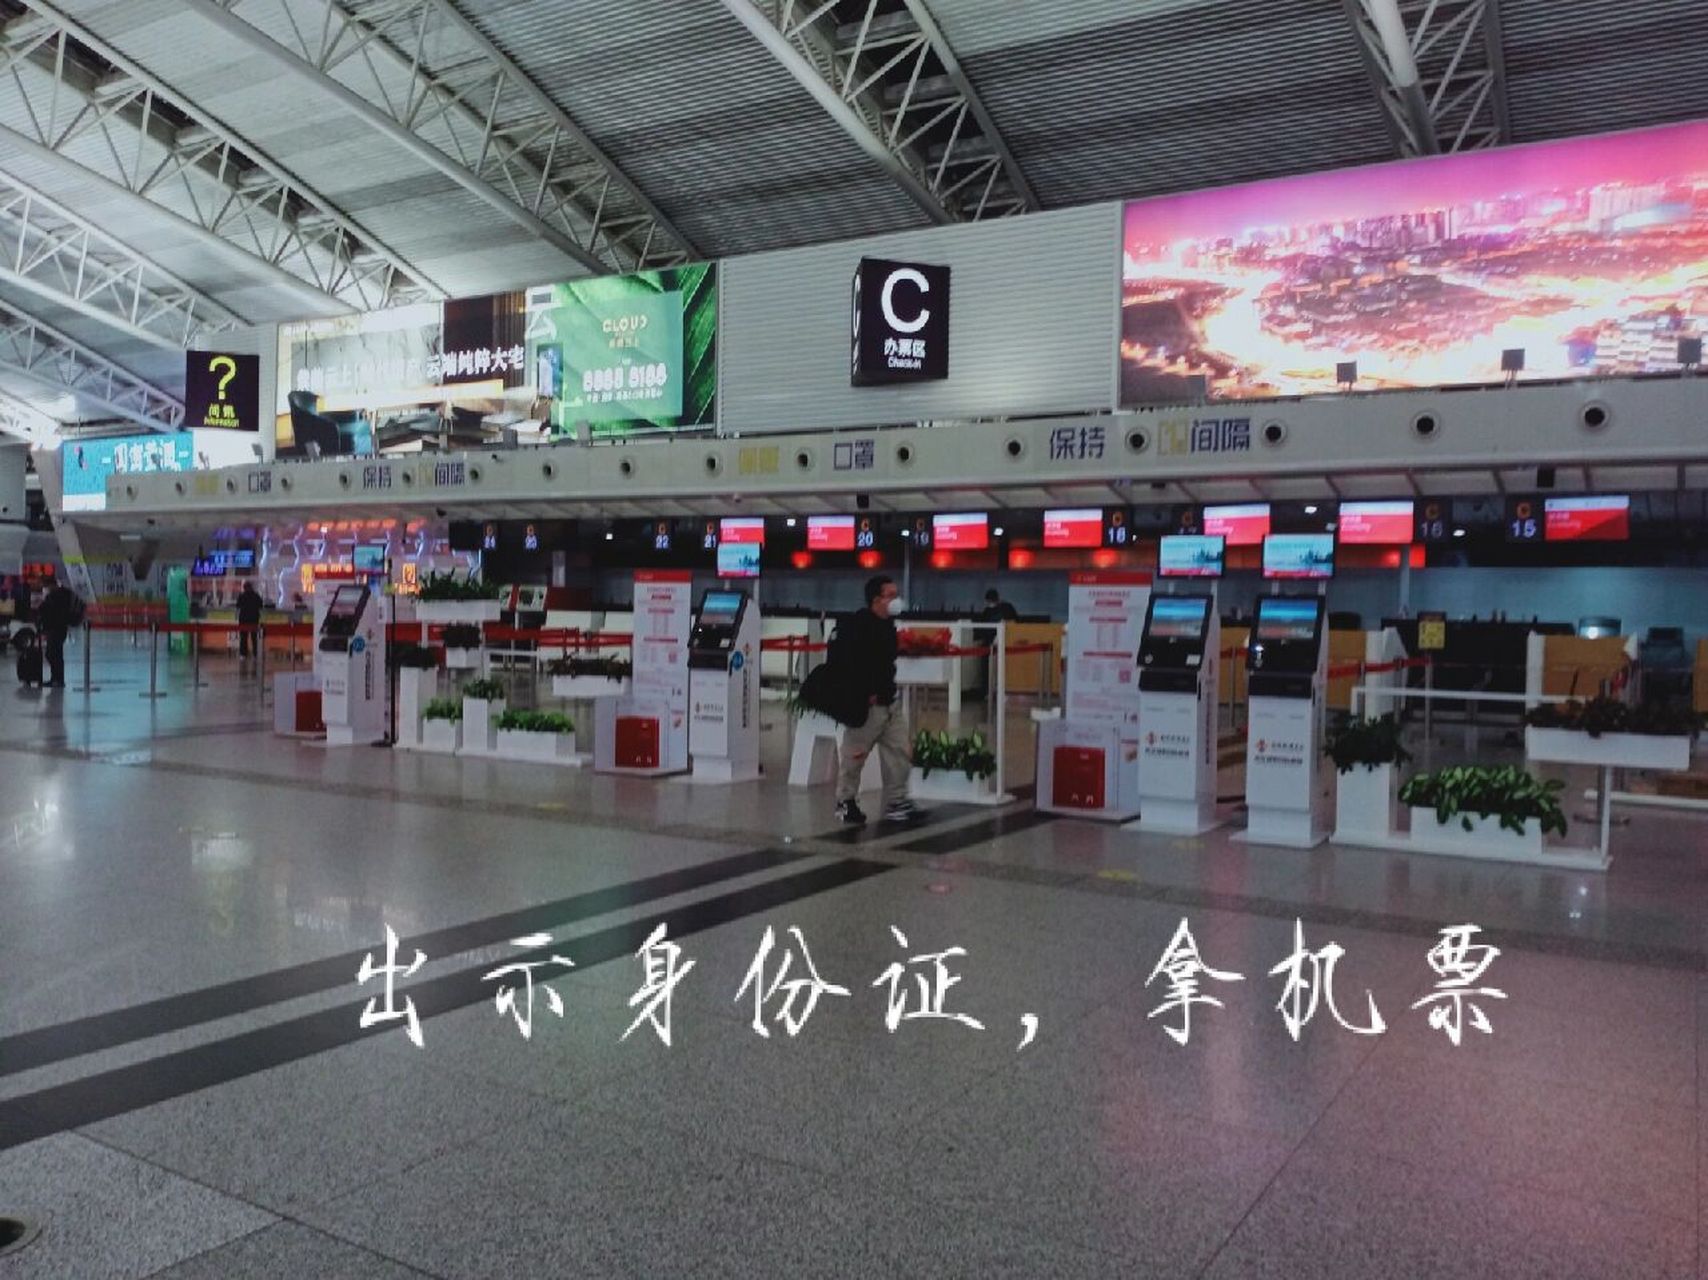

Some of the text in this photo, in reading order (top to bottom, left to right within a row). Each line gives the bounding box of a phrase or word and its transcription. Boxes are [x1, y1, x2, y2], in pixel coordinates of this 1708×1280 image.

[881, 268, 930, 333] C
[884, 338, 926, 358] 办票区
[1050, 429, 1105, 460] 保持
[1191, 418, 1252, 453] 间隔
[834, 440, 874, 471] 口罩
[1511, 519, 1537, 538] 15
